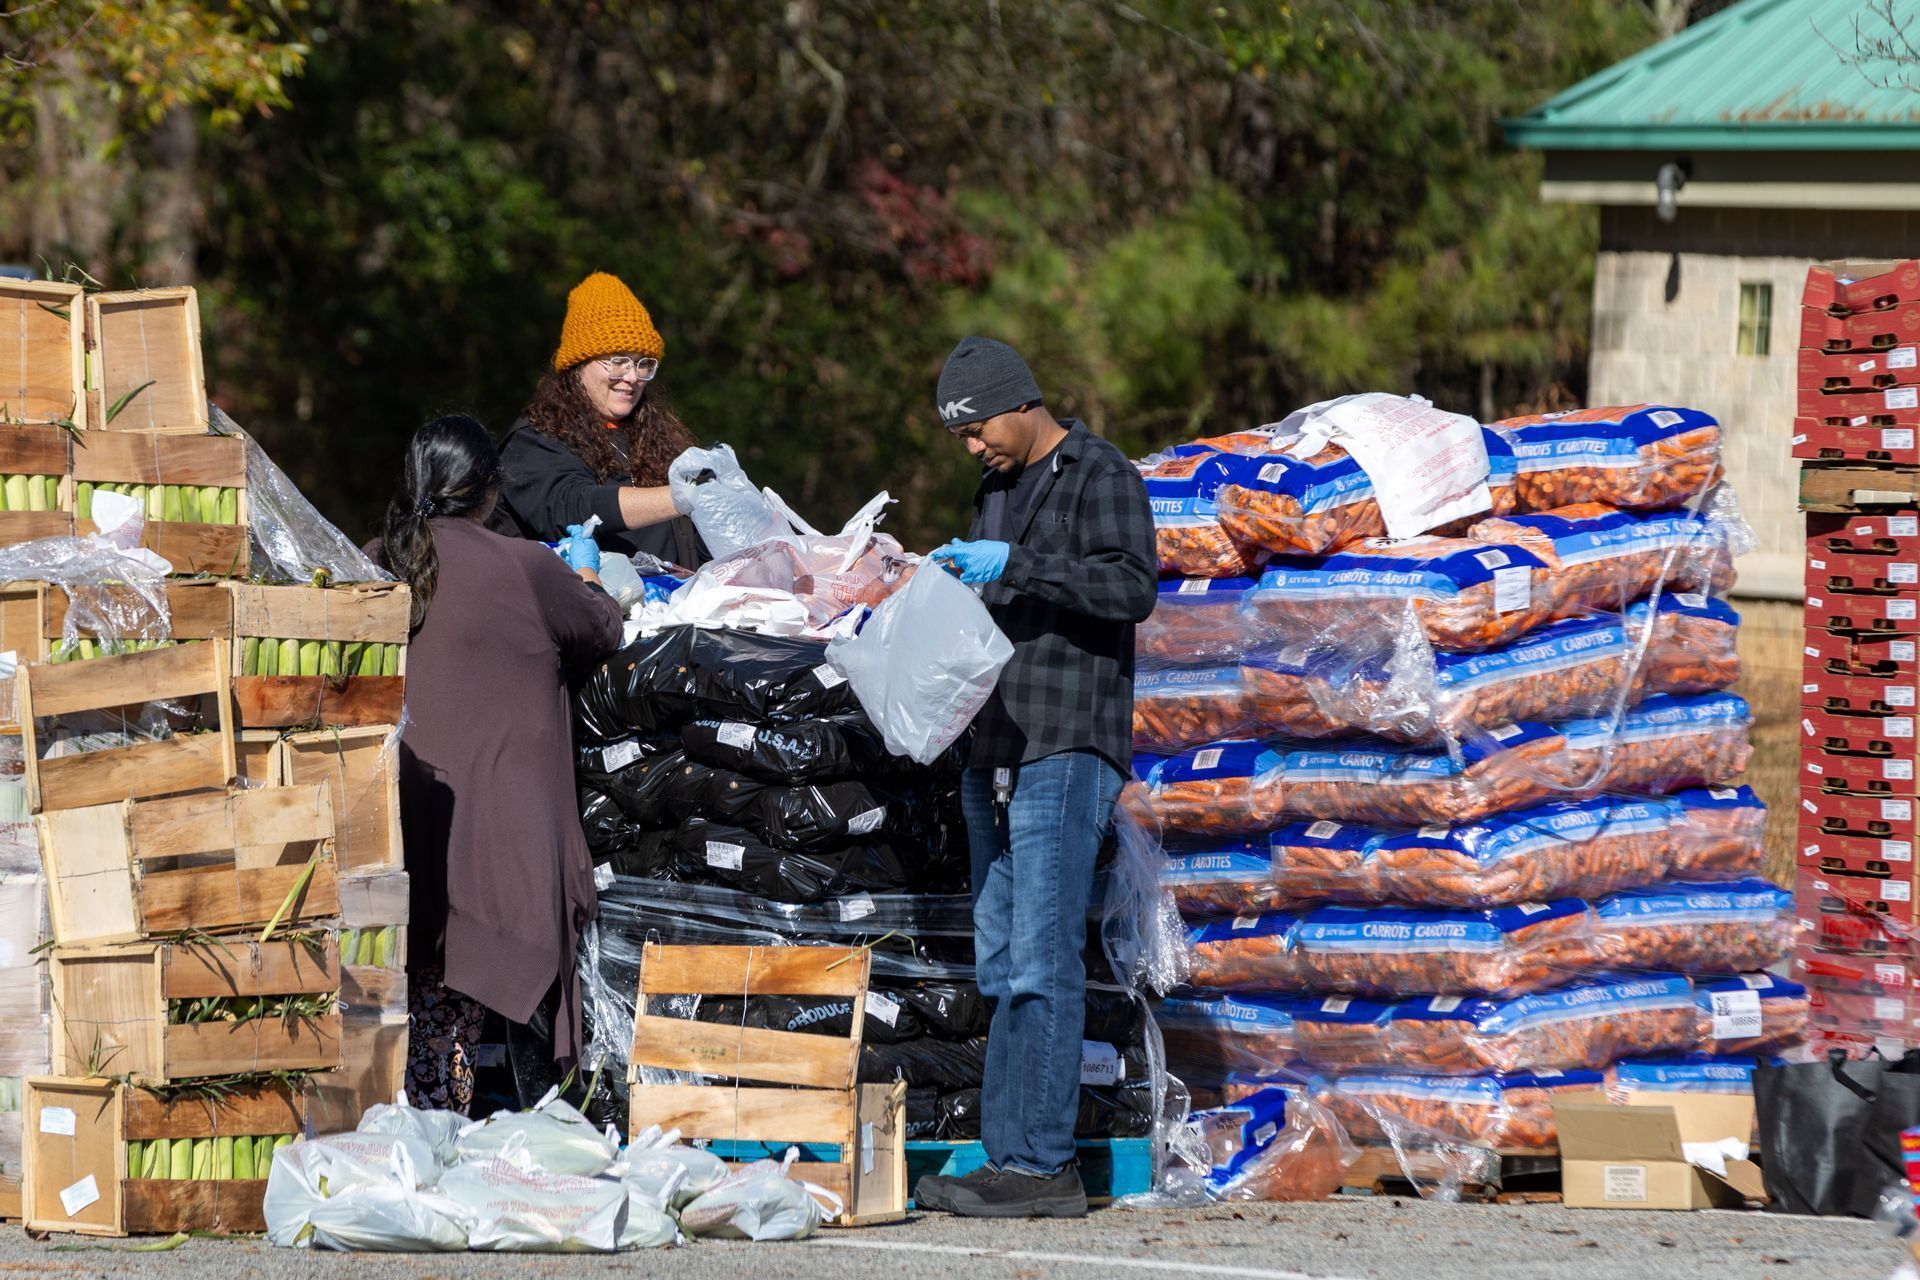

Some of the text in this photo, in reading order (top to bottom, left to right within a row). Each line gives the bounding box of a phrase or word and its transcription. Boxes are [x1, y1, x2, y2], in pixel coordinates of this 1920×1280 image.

[938, 397, 977, 421] MK
[1556, 440, 1608, 454] CAROTTES
[1327, 571, 1371, 585] CARROTS
[1510, 644, 1556, 663] CARROTS
[1561, 631, 1614, 652] CAROTTES
[758, 729, 800, 754] U.S.A.
[1340, 754, 1384, 769] CARROTS
[1550, 811, 1596, 830] CARROTS
[1190, 855, 1232, 869] CAROTTES
[1362, 924, 1411, 938] CARROTS
[1414, 924, 1467, 937] CAROTTES
[1563, 987, 1613, 1006] CARROTS
[1615, 981, 1669, 999] CAROTTES
[1216, 1002, 1259, 1020] CAROTTES
